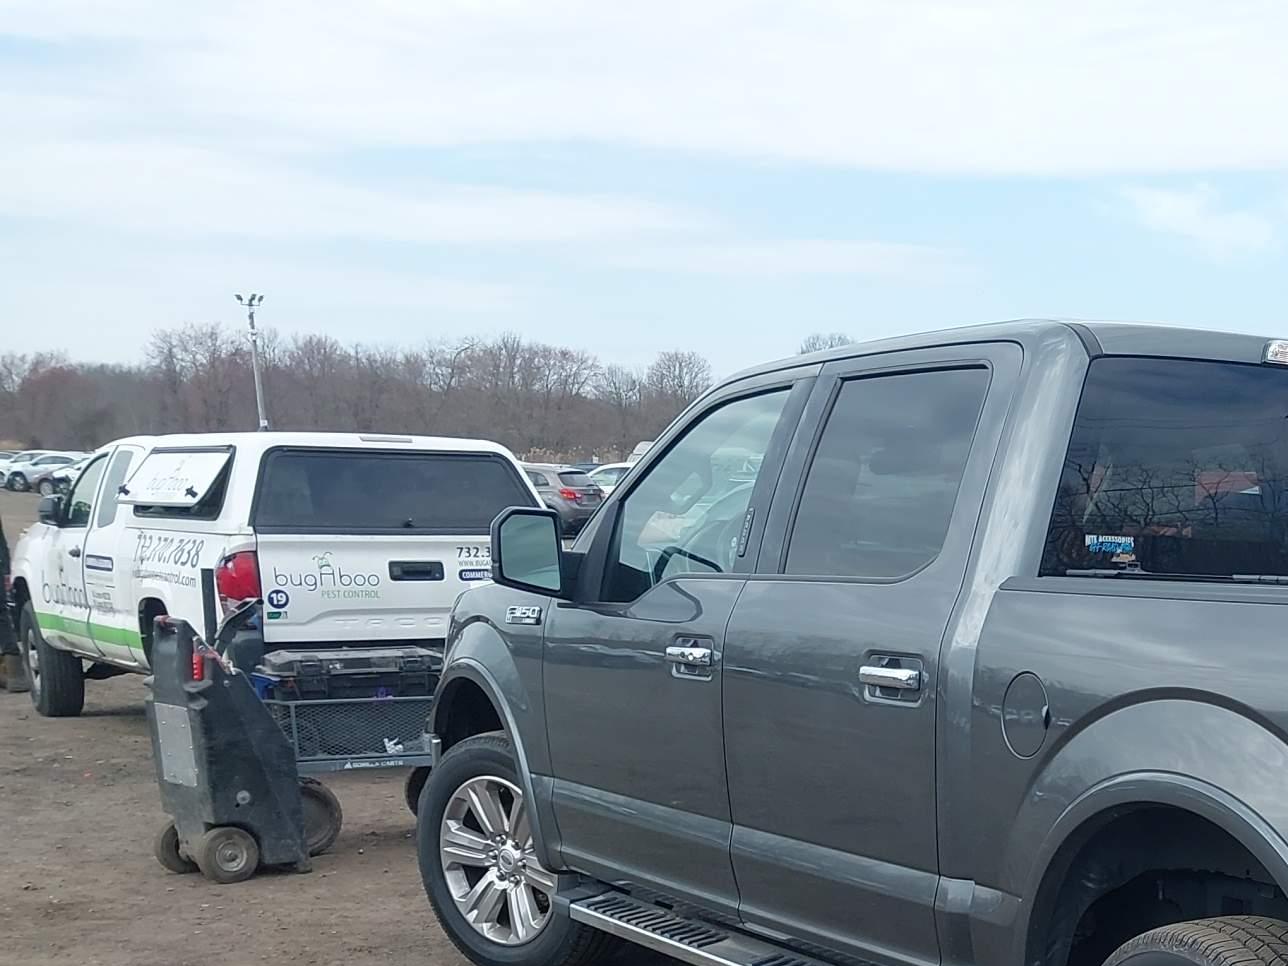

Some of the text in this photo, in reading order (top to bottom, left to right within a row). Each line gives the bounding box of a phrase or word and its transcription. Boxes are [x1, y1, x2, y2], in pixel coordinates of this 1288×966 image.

[270, 592, 286, 605] 19
[321, 590, 381, 599] PEST CONTROL
